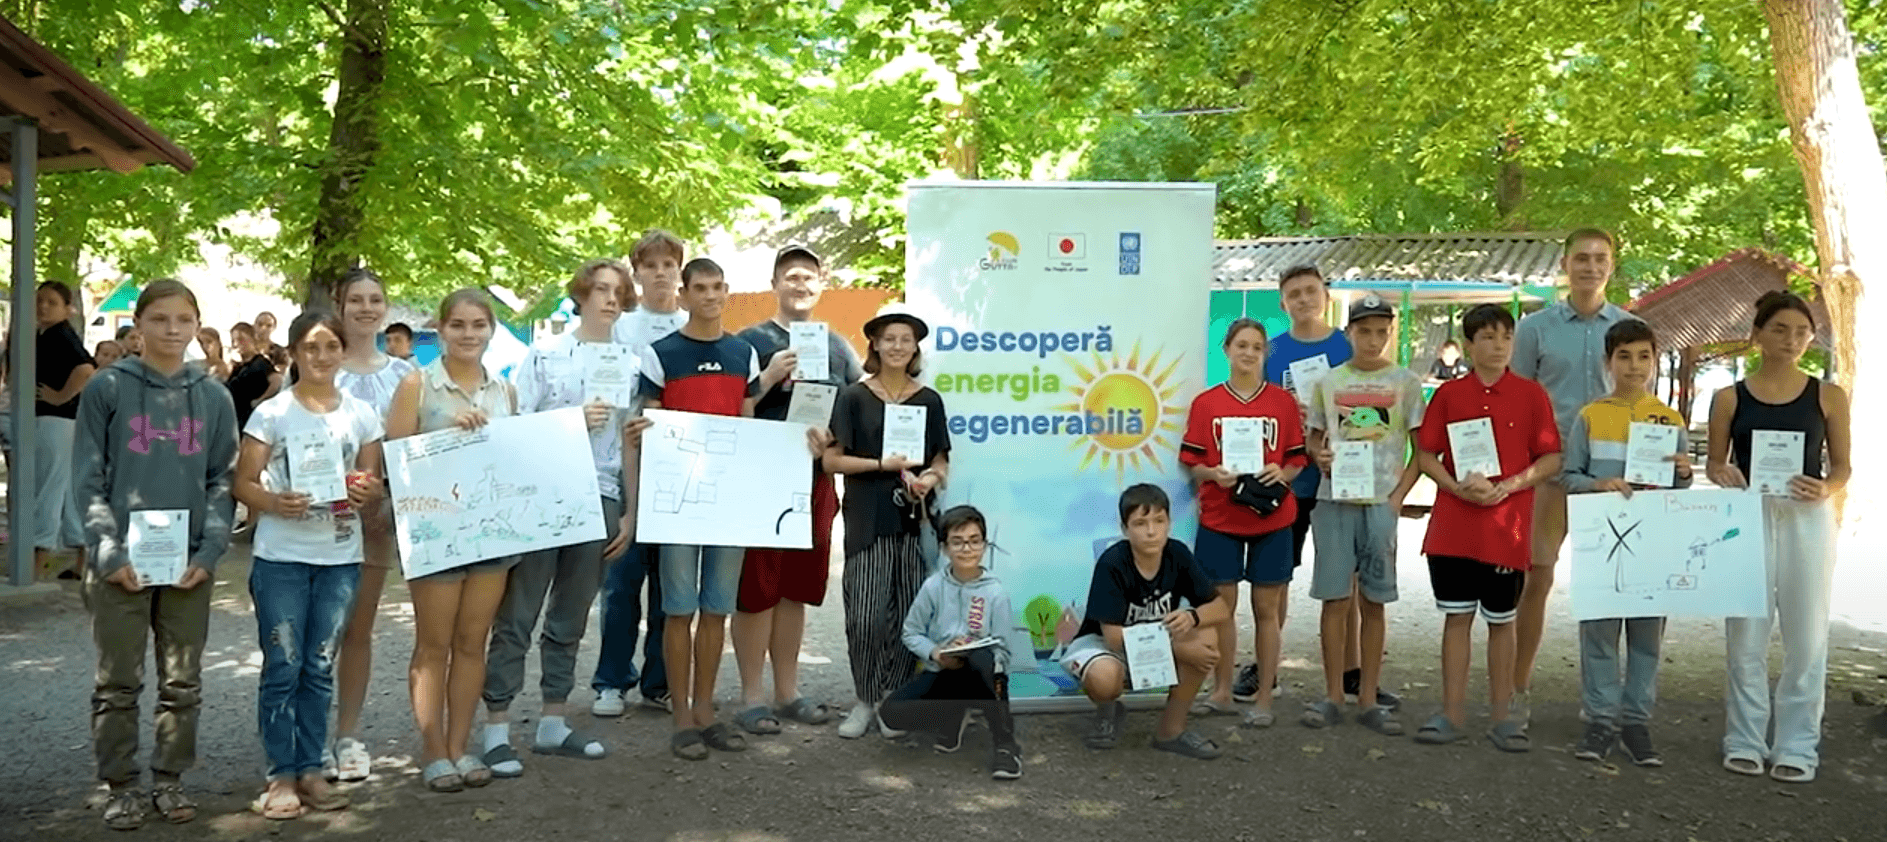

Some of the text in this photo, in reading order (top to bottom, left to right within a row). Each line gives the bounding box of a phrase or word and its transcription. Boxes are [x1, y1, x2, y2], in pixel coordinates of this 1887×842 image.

[936, 325, 1113, 359] Descoperă
[934, 365, 1061, 402] energia
[948, 407, 1143, 443] egenerabilă
